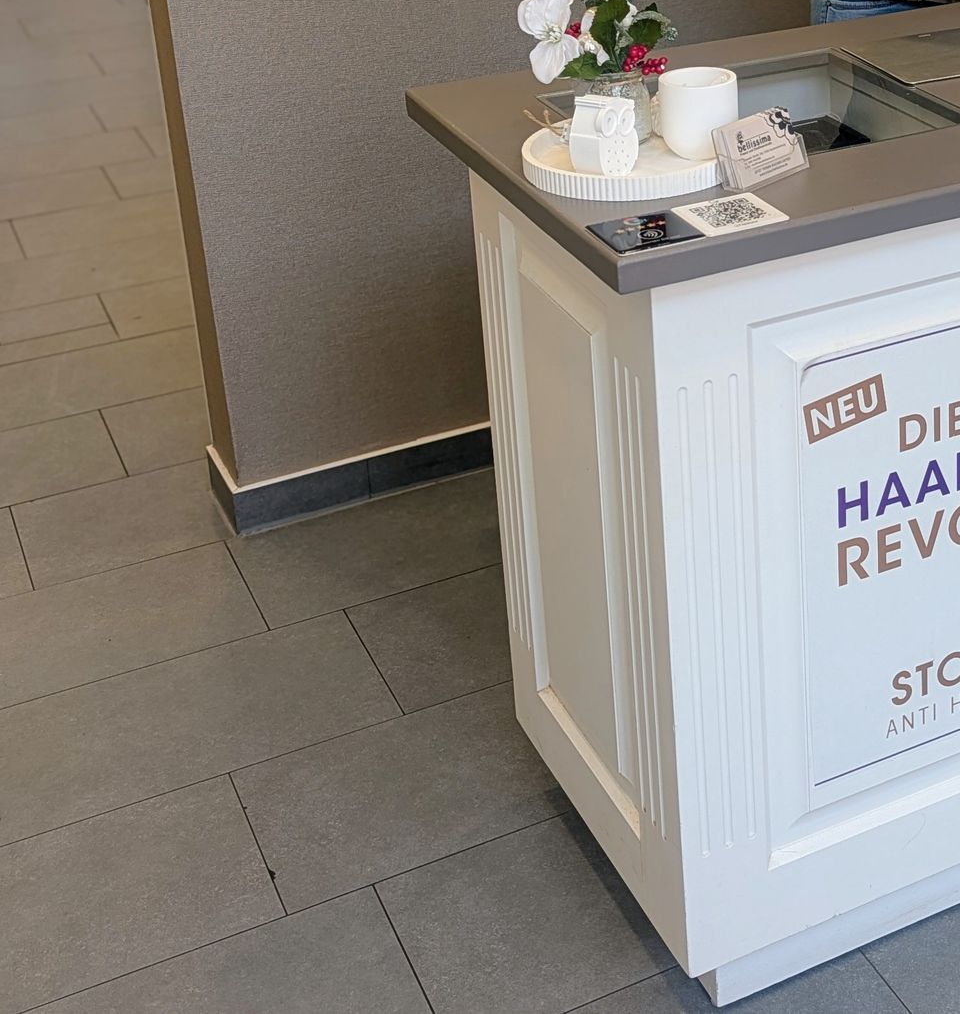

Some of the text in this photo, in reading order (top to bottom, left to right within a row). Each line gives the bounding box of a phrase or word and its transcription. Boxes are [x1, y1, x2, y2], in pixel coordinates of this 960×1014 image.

[737, 134, 772, 153] bellissima
[808, 382, 879, 438] NEU
[886, 702, 938, 739] ANTI
